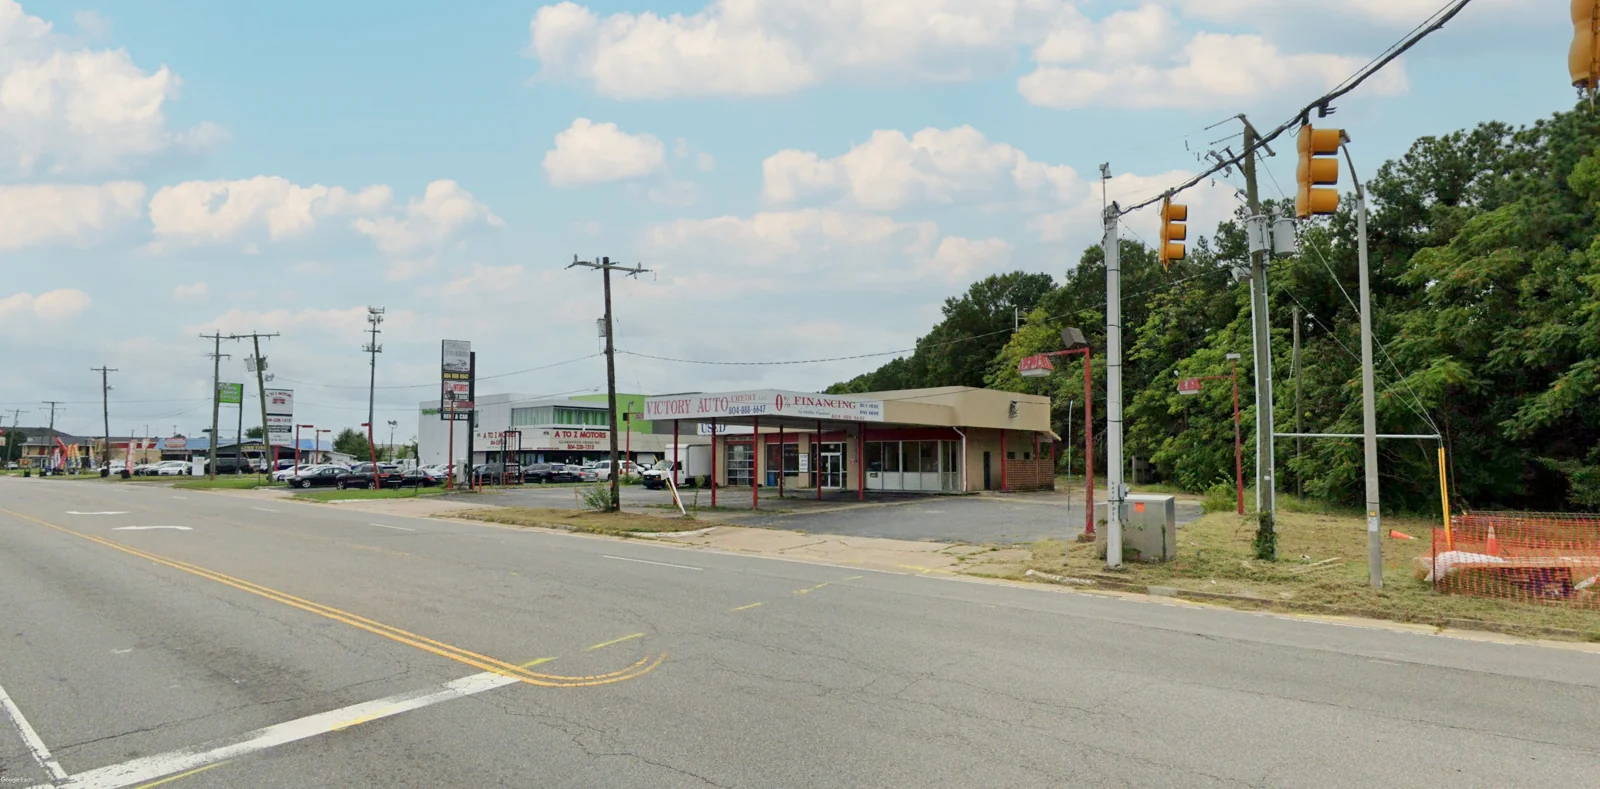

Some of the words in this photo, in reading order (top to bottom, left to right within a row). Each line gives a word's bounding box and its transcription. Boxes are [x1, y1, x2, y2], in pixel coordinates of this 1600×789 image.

[646, 399, 691, 415] VICTORY
[697, 396, 729, 413] AUTO
[794, 396, 856, 409] FINANCING
[729, 404, 766, 415] 804-888-6647
[579, 431, 607, 439] MOTORS
